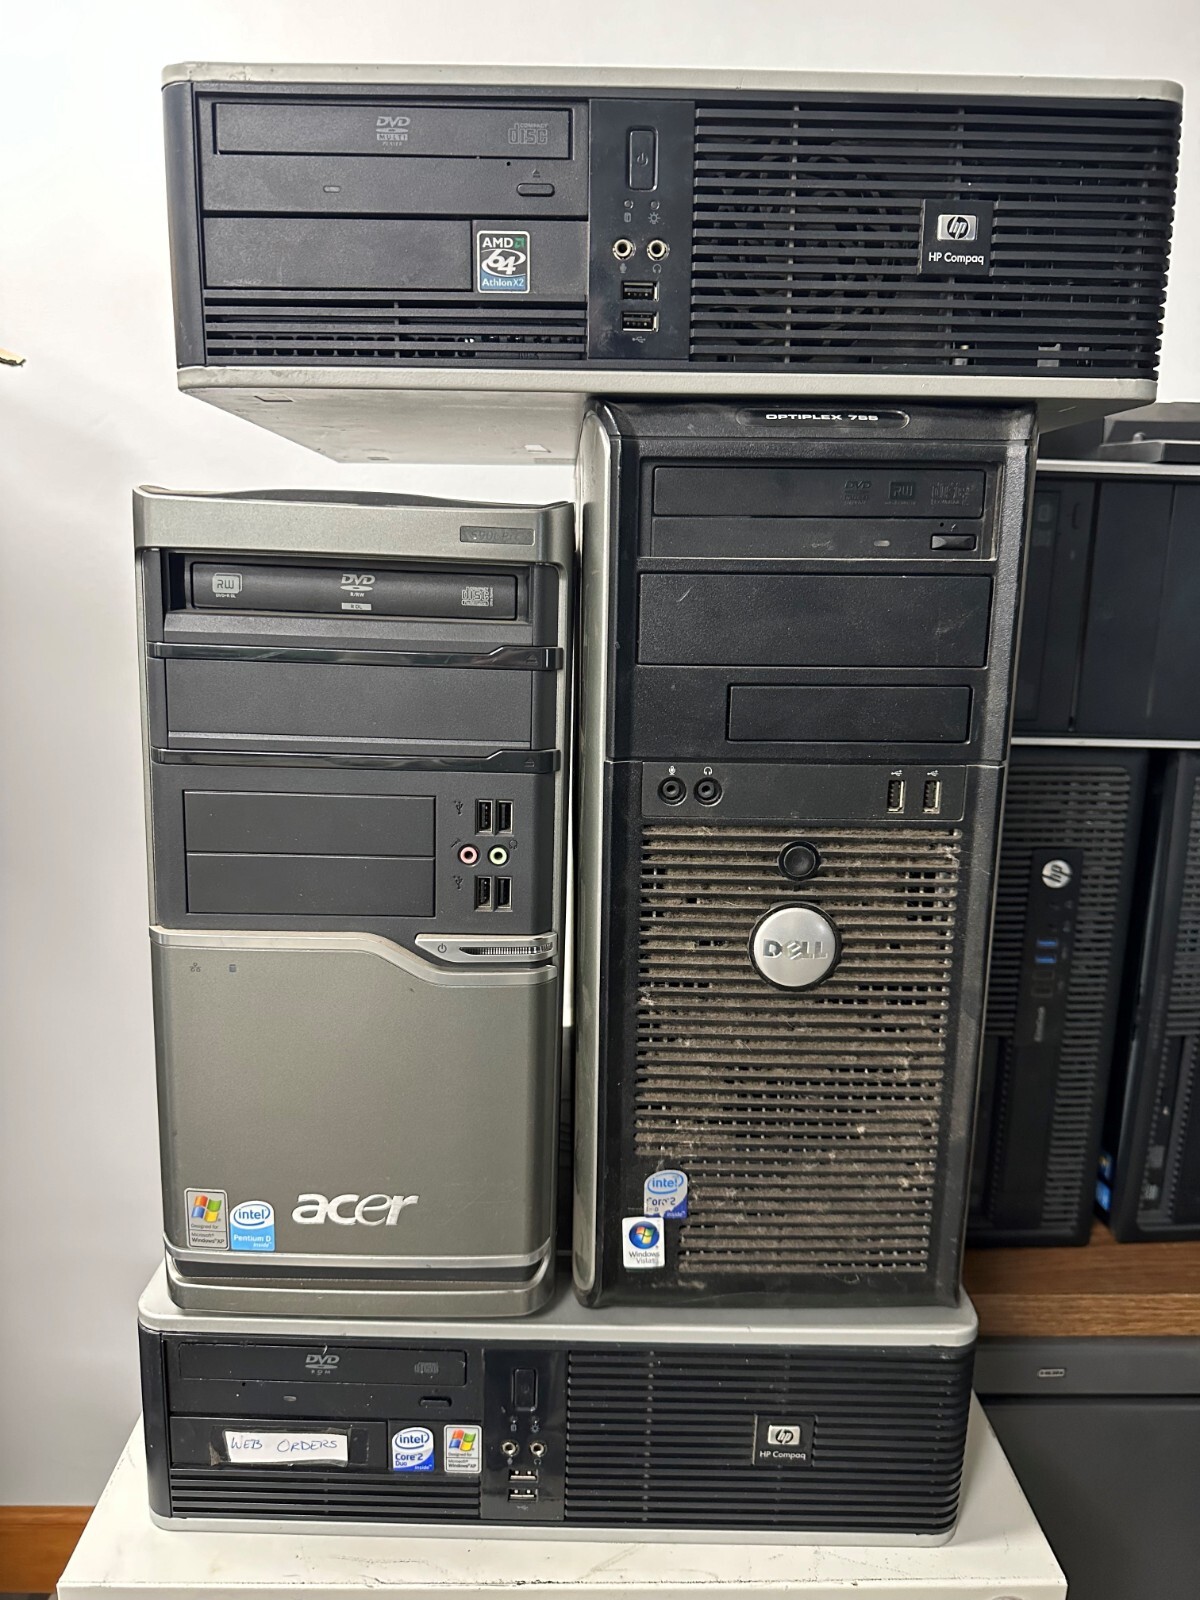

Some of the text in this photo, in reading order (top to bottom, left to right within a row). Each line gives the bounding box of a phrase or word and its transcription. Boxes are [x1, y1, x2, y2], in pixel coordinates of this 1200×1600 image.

[376, 116, 411, 128] DVD
[482, 237, 514, 248] AMD
[487, 249, 517, 275] 64
[928, 251, 985, 266] HP Compaq
[482, 278, 524, 287] Athlon X2
[216, 579, 235, 590] RW
[341, 573, 376, 586] DVD
[763, 938, 828, 960] DELL
[652, 1177, 678, 1189] intel
[238, 1208, 265, 1220] intel
[291, 1193, 420, 1227] acer
[233, 1234, 264, 1242] Pentium
[305, 1354, 340, 1365] DVD
[230, 1437, 338, 1453] WEB ORDERS
[399, 1434, 425, 1444] intel
[395, 1452, 424, 1461] Core 2
[759, 1450, 806, 1460] HP Compaq
